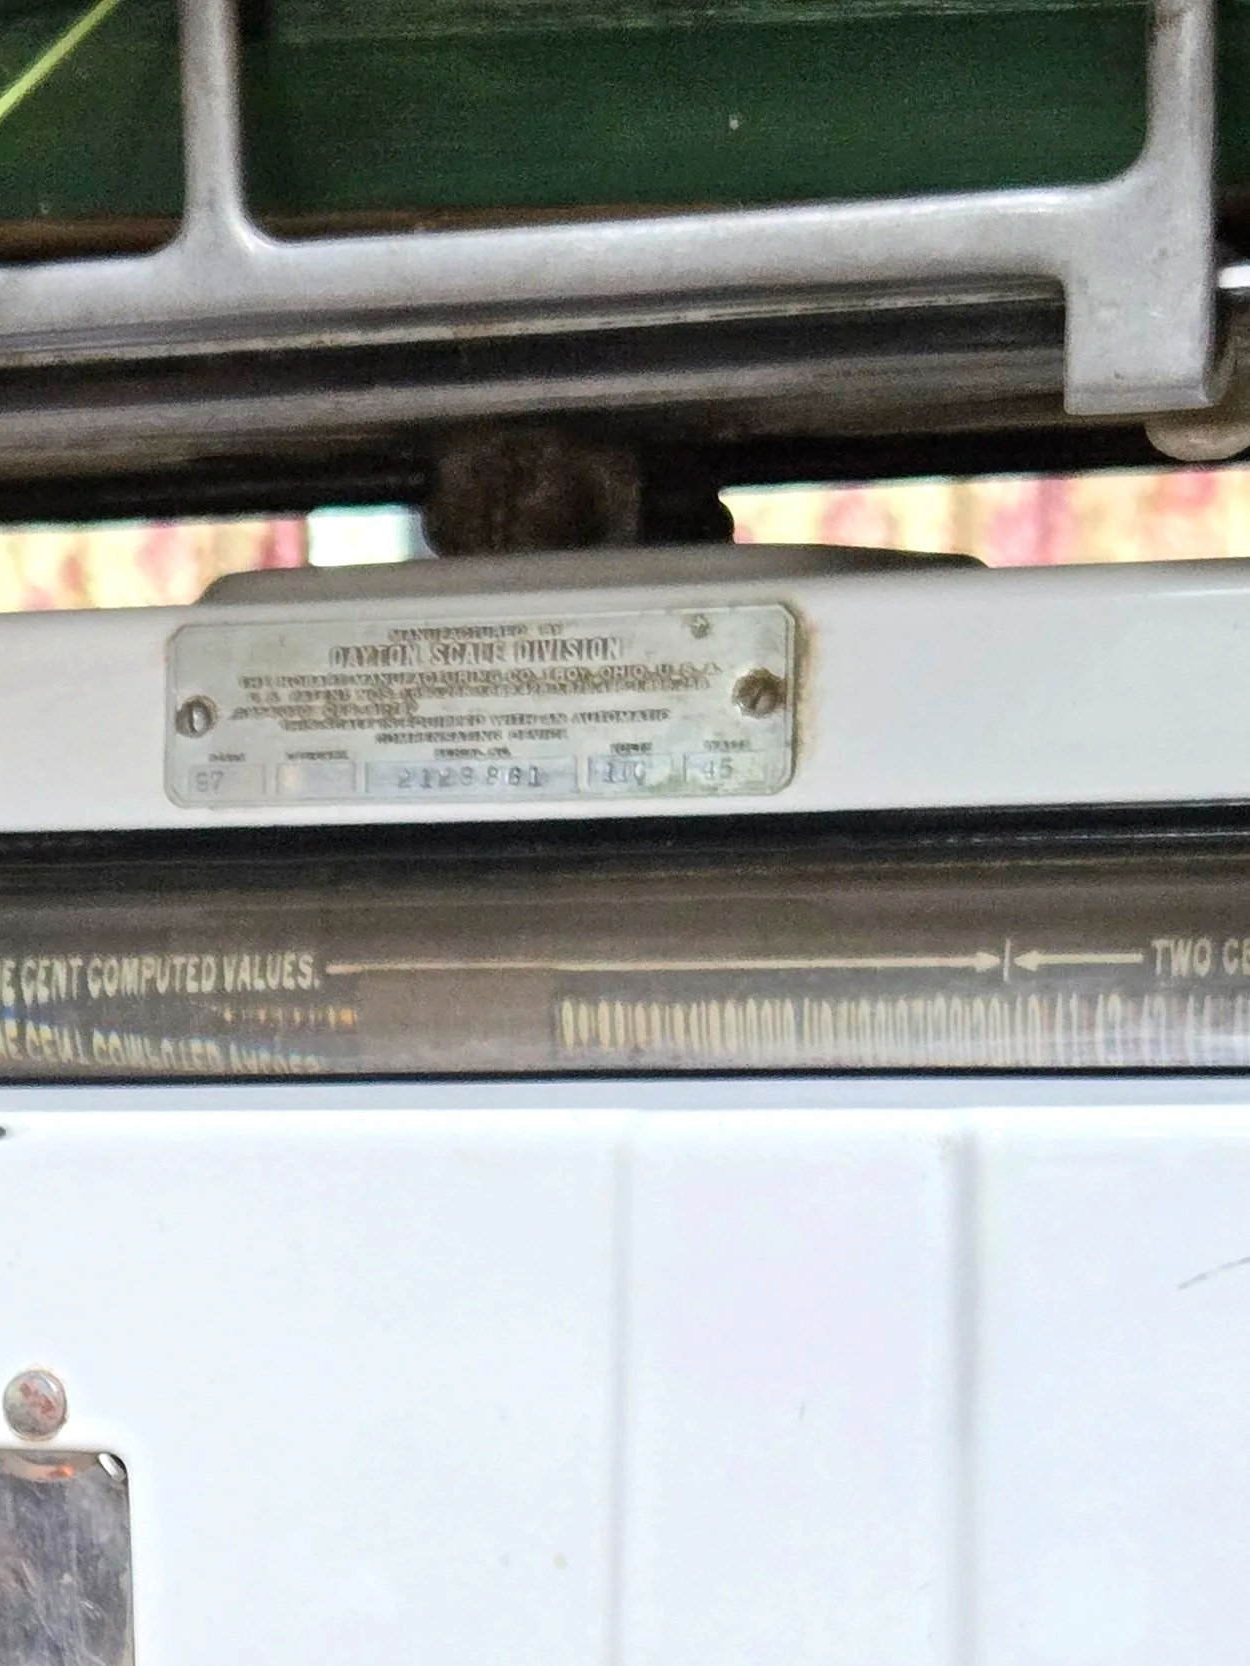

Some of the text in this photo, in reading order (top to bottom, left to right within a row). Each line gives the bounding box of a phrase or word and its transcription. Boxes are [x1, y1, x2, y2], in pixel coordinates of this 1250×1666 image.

[328, 637, 622, 668] DAYTON SCALE DIVISION
[1150, 937, 1213, 978] TWO
[20, 955, 84, 1006] CENT
[87, 953, 218, 998] COMPUTED
[222, 951, 321, 992] VALUES.
